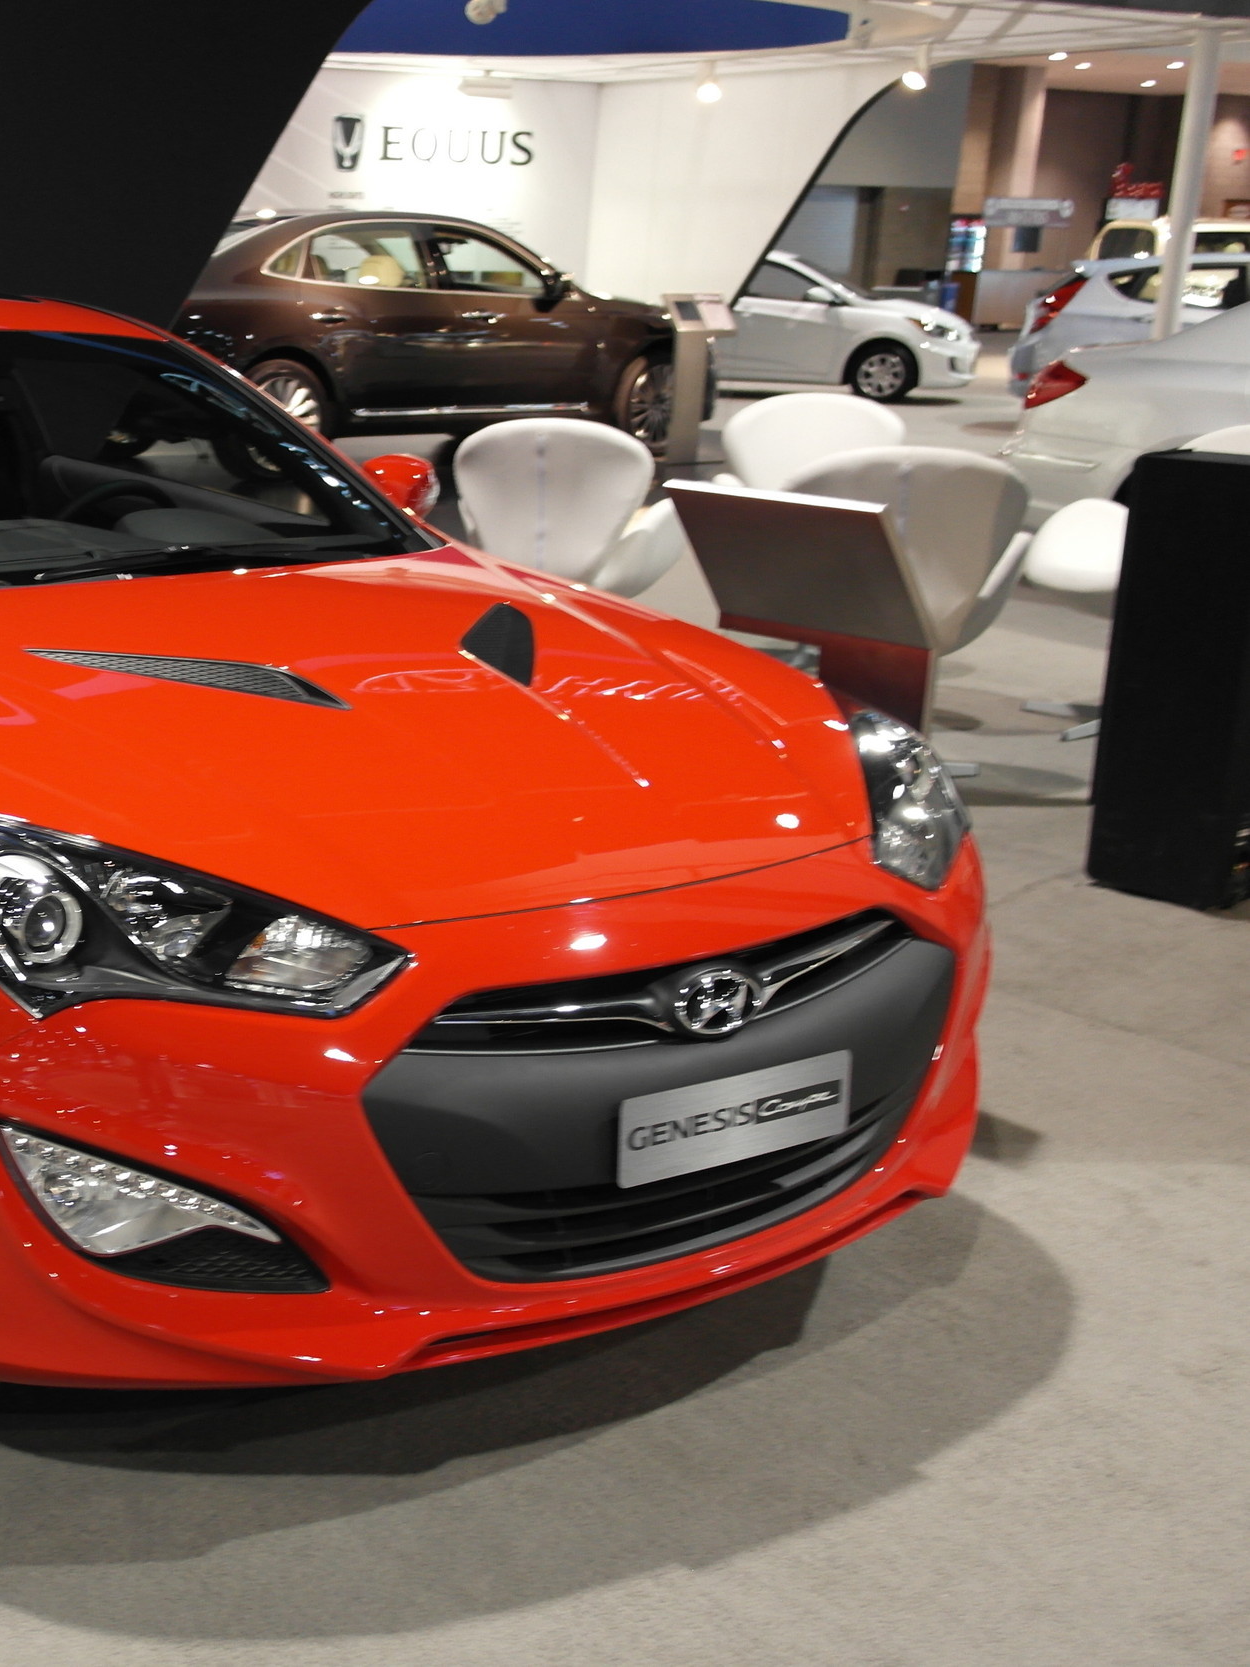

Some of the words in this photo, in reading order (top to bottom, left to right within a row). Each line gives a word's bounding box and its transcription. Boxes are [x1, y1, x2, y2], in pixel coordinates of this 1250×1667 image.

[379, 126, 534, 166] EQUUS
[628, 1102, 756, 1151] GENESIS
[758, 1090, 838, 1118] Coupe
